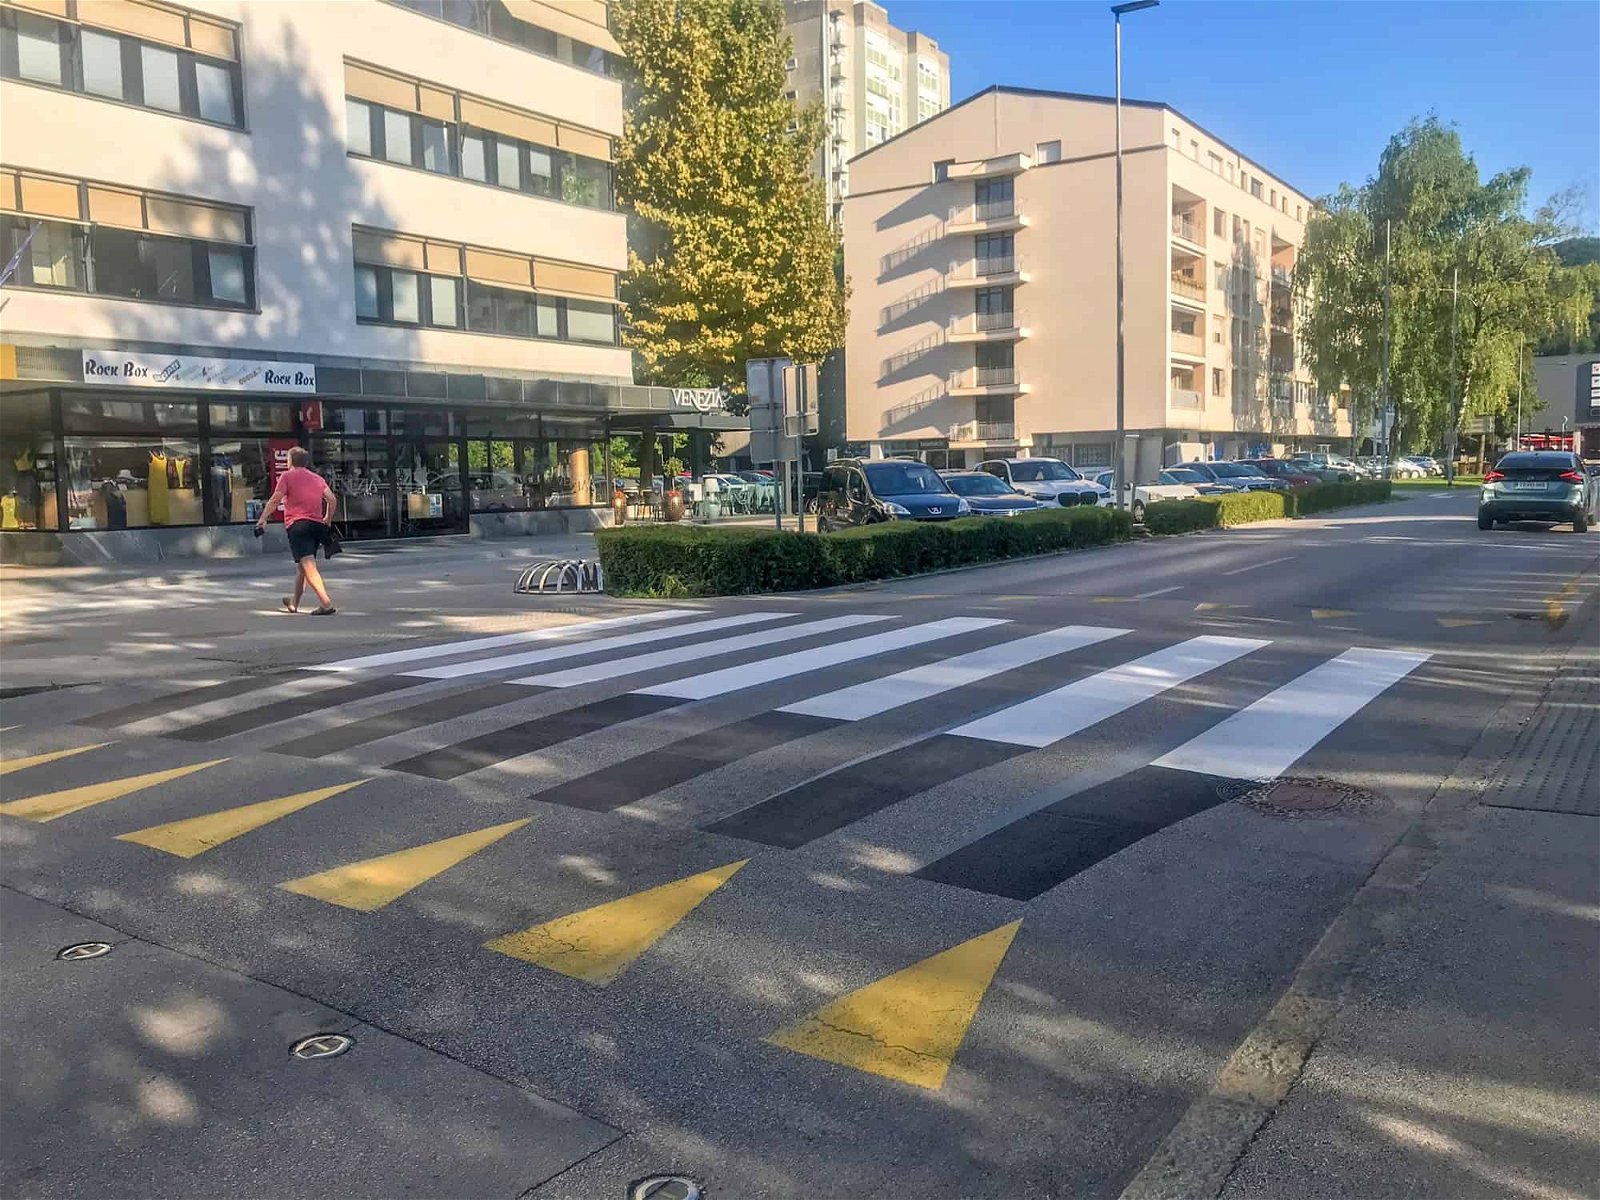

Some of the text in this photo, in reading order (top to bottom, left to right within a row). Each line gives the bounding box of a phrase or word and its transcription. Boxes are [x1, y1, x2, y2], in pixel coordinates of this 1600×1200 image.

[123, 362, 149, 378] Box
[295, 371, 315, 386] Box
[671, 386, 724, 412] VENEZIA
